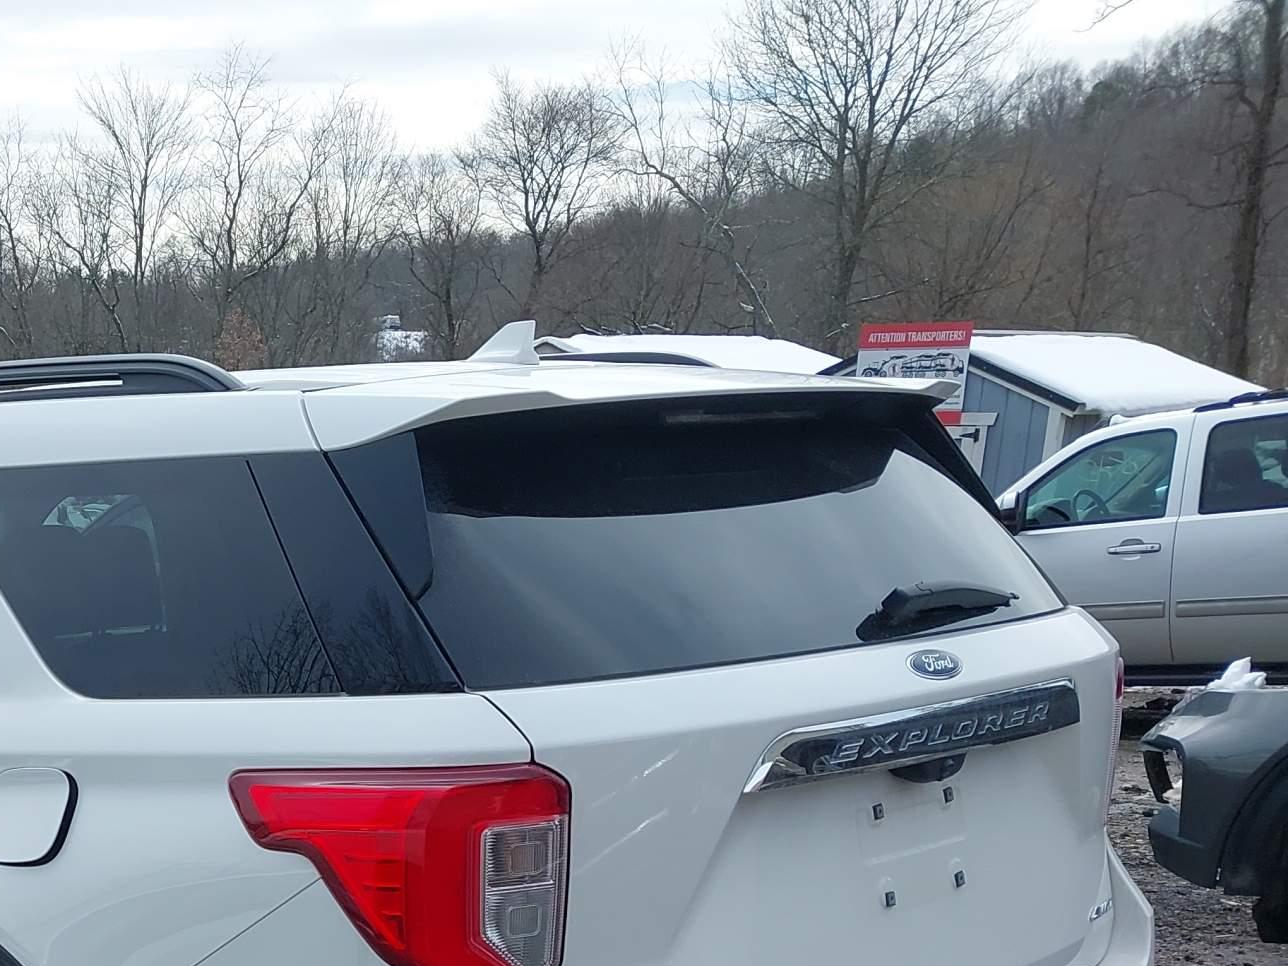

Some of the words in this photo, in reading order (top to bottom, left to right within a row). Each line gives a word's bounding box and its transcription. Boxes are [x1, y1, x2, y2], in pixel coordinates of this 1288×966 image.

[868, 332, 906, 343] ATTENTION
[908, 330, 966, 342] TRANSPORTERS!
[922, 654, 954, 671] Ford
[829, 702, 1050, 764] EXPLORER
